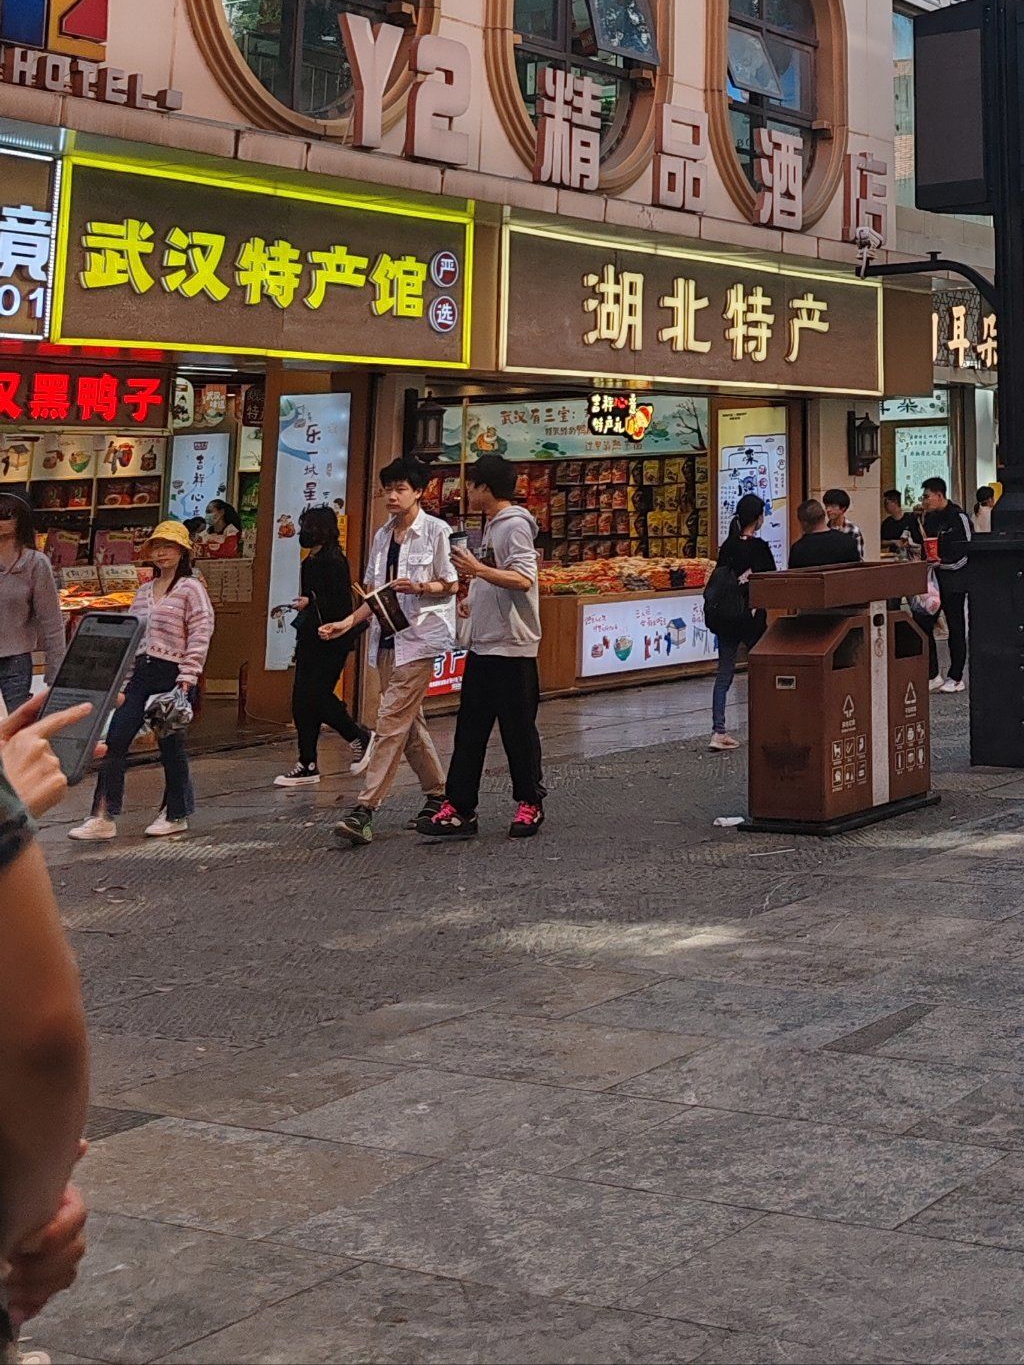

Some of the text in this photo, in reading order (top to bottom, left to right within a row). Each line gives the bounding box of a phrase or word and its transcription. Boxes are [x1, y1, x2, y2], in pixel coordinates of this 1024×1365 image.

[79, 218, 428, 319] 武汉特产馆
[583, 264, 830, 364] 湖北特产
[932, 305, 999, 368] 耳朵
